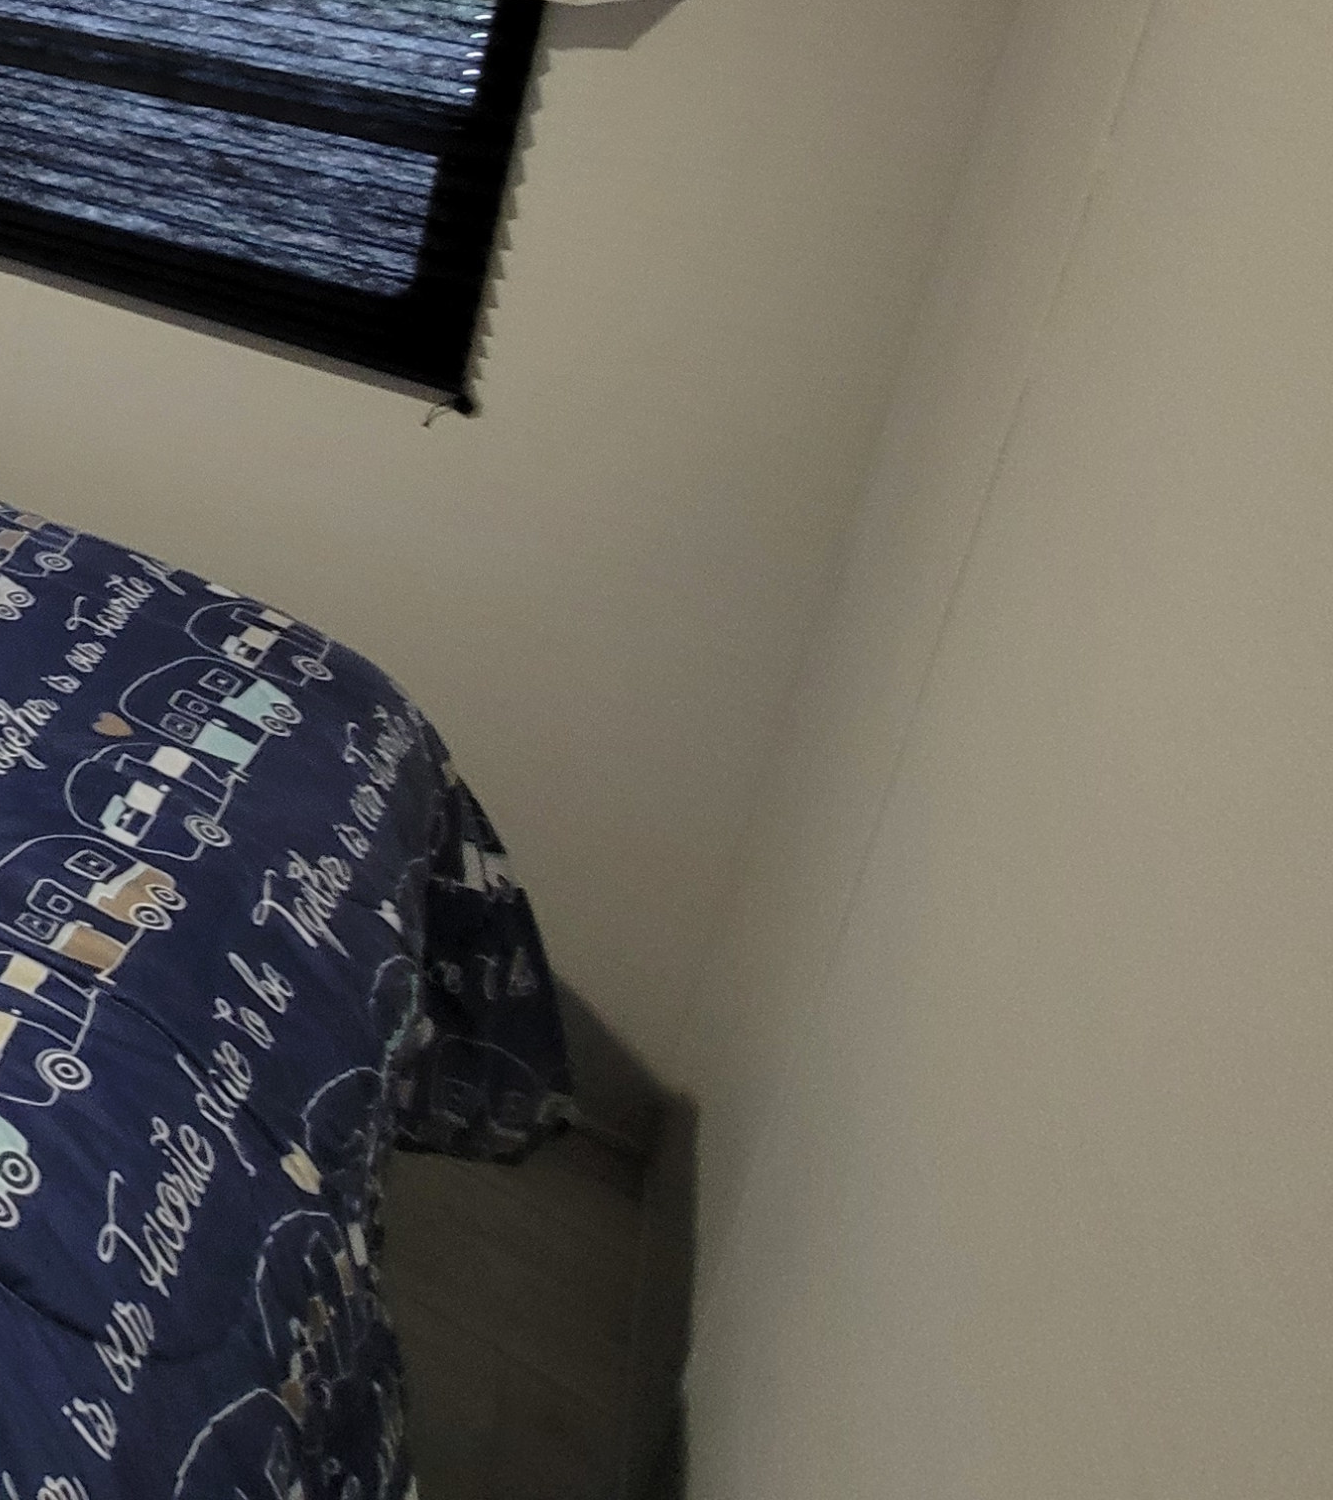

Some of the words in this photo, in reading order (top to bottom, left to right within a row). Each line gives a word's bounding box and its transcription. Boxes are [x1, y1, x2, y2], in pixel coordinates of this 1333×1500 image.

[228, 952, 297, 1014] be
[212, 997, 274, 1050] to
[97, 1116, 216, 1300] Favorite
[95, 1299, 156, 1395] our
[60, 1397, 118, 1461] is
